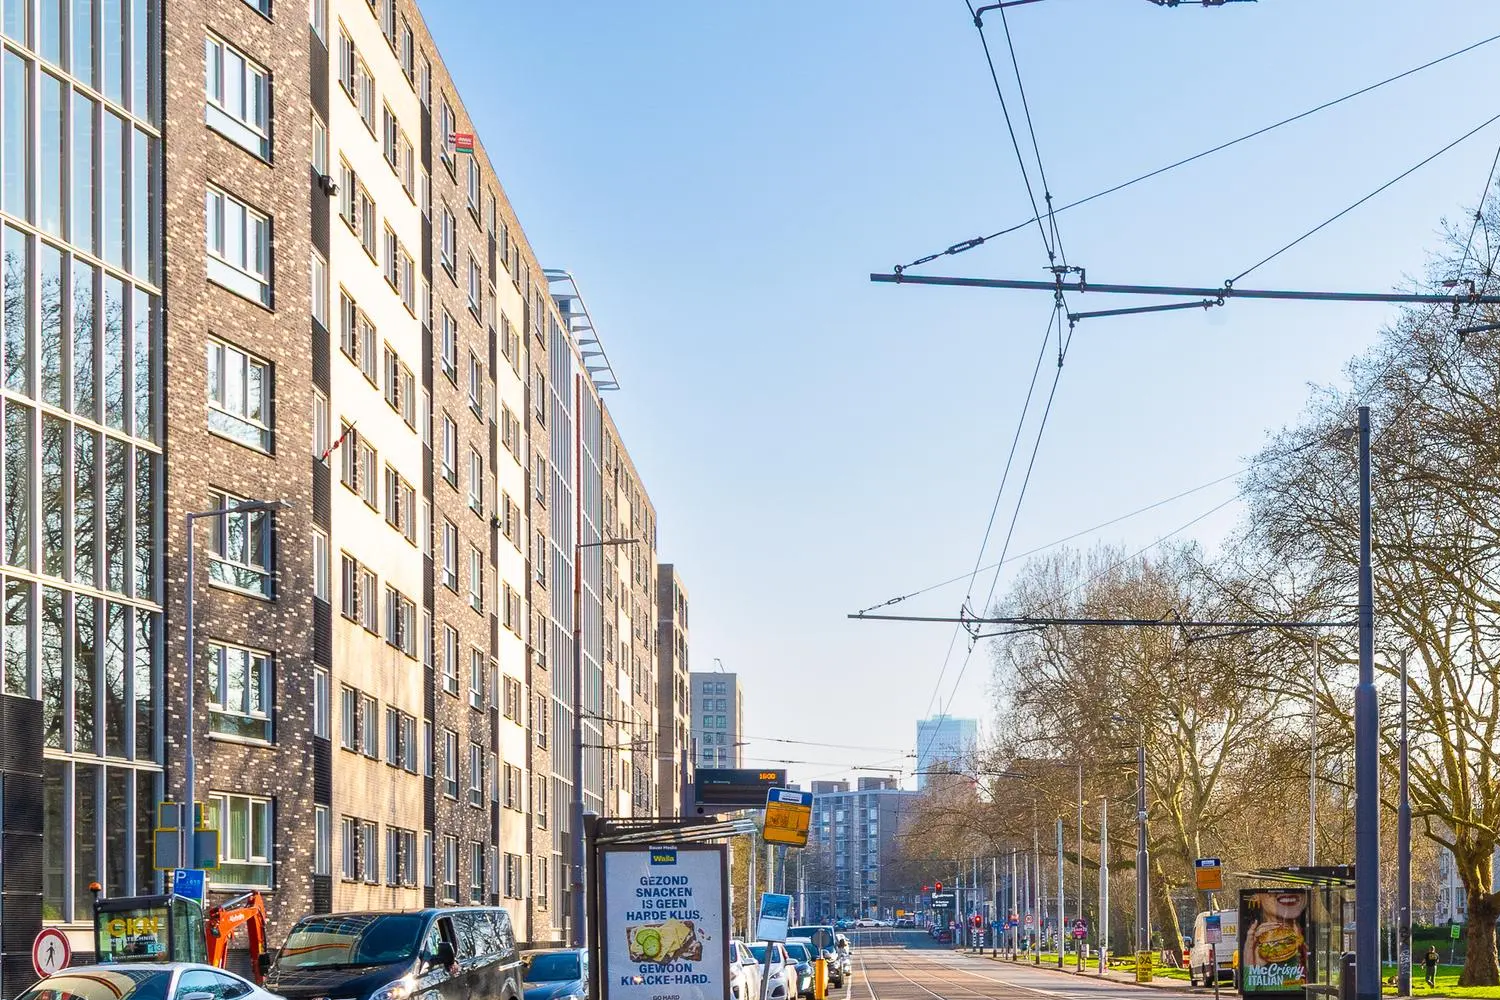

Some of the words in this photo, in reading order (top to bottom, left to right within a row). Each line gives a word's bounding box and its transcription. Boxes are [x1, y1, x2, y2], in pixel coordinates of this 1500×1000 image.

[176, 871, 186, 883] P
[640, 875, 688, 886] GEZOND
[636, 887, 692, 897] SNACKEN
[642, 900, 653, 909] IS
[656, 898, 687, 908] GEEN
[626, 911, 667, 921] HARDE
[639, 963, 692, 974] GEWOON
[1249, 963, 1305, 980] McCrispy
[1248, 975, 1283, 985] ITALIAN
